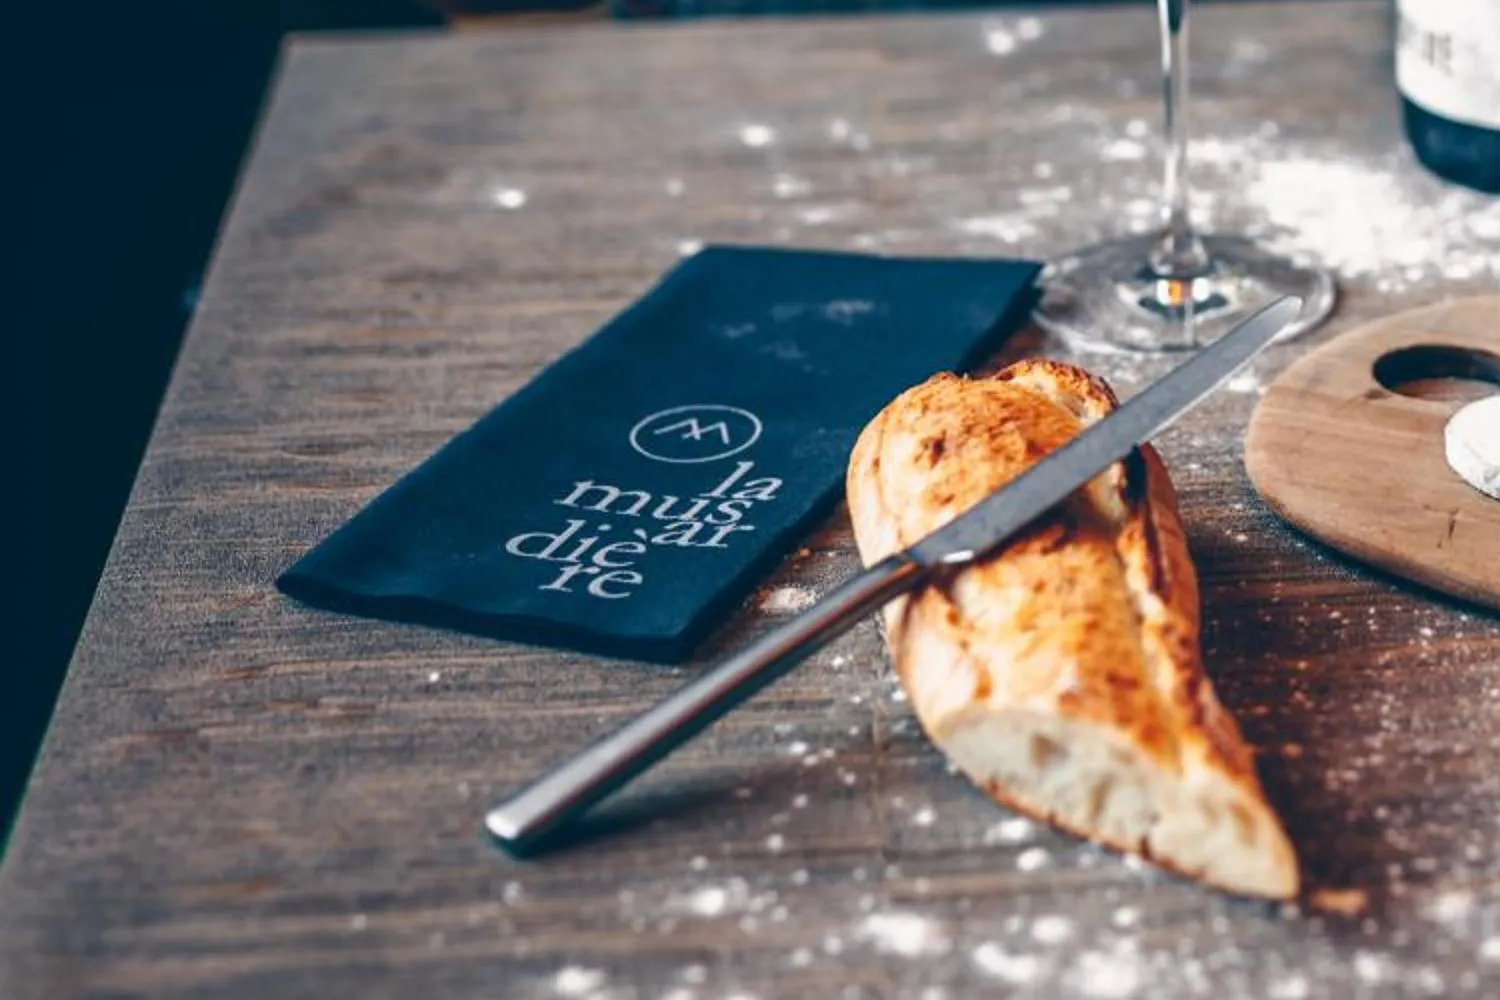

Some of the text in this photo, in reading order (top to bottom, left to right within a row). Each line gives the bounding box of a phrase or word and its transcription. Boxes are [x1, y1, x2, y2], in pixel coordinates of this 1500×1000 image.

[700, 461, 783, 501] la
[553, 479, 754, 525] mus
[505, 519, 648, 567] diè
[650, 520, 755, 549] ar
[537, 563, 644, 599] re
